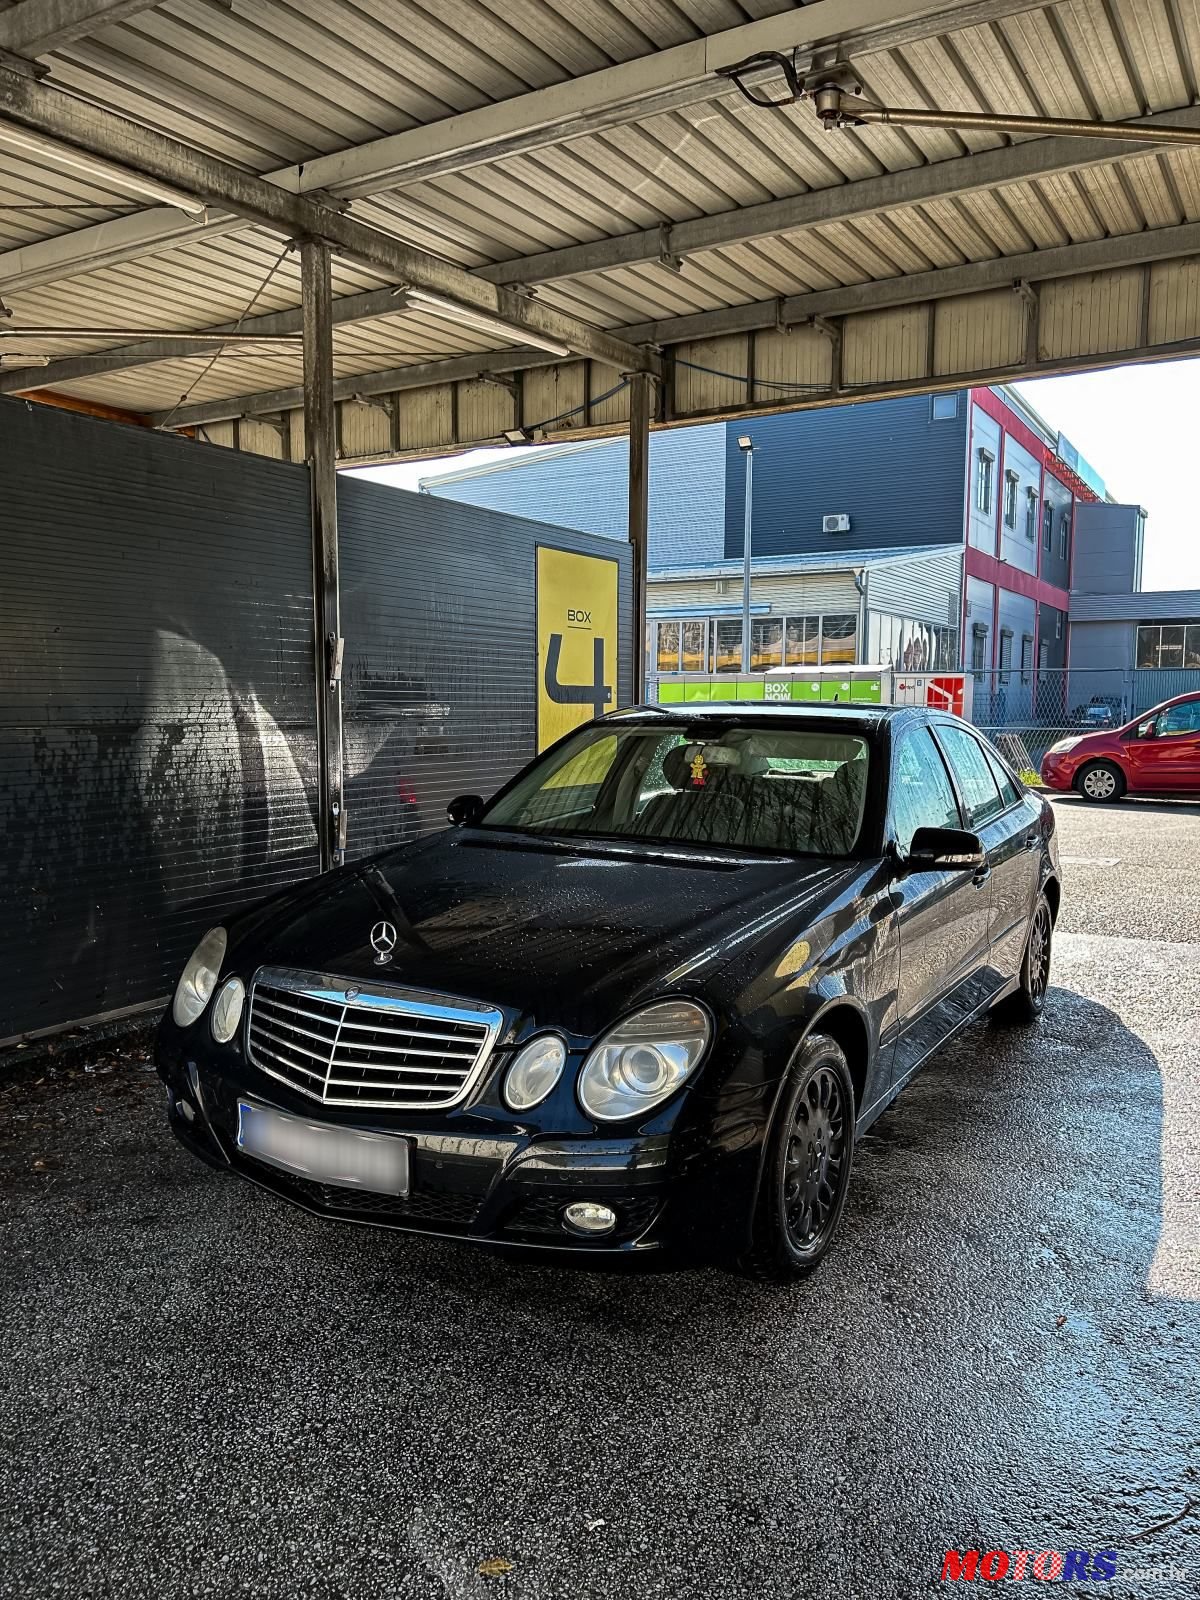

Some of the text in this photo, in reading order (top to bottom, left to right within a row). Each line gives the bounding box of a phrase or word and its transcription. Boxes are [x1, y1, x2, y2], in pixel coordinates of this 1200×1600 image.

[567, 609, 592, 623] BOX
[545, 634, 612, 719] 4
[765, 683, 789, 692] BOX
